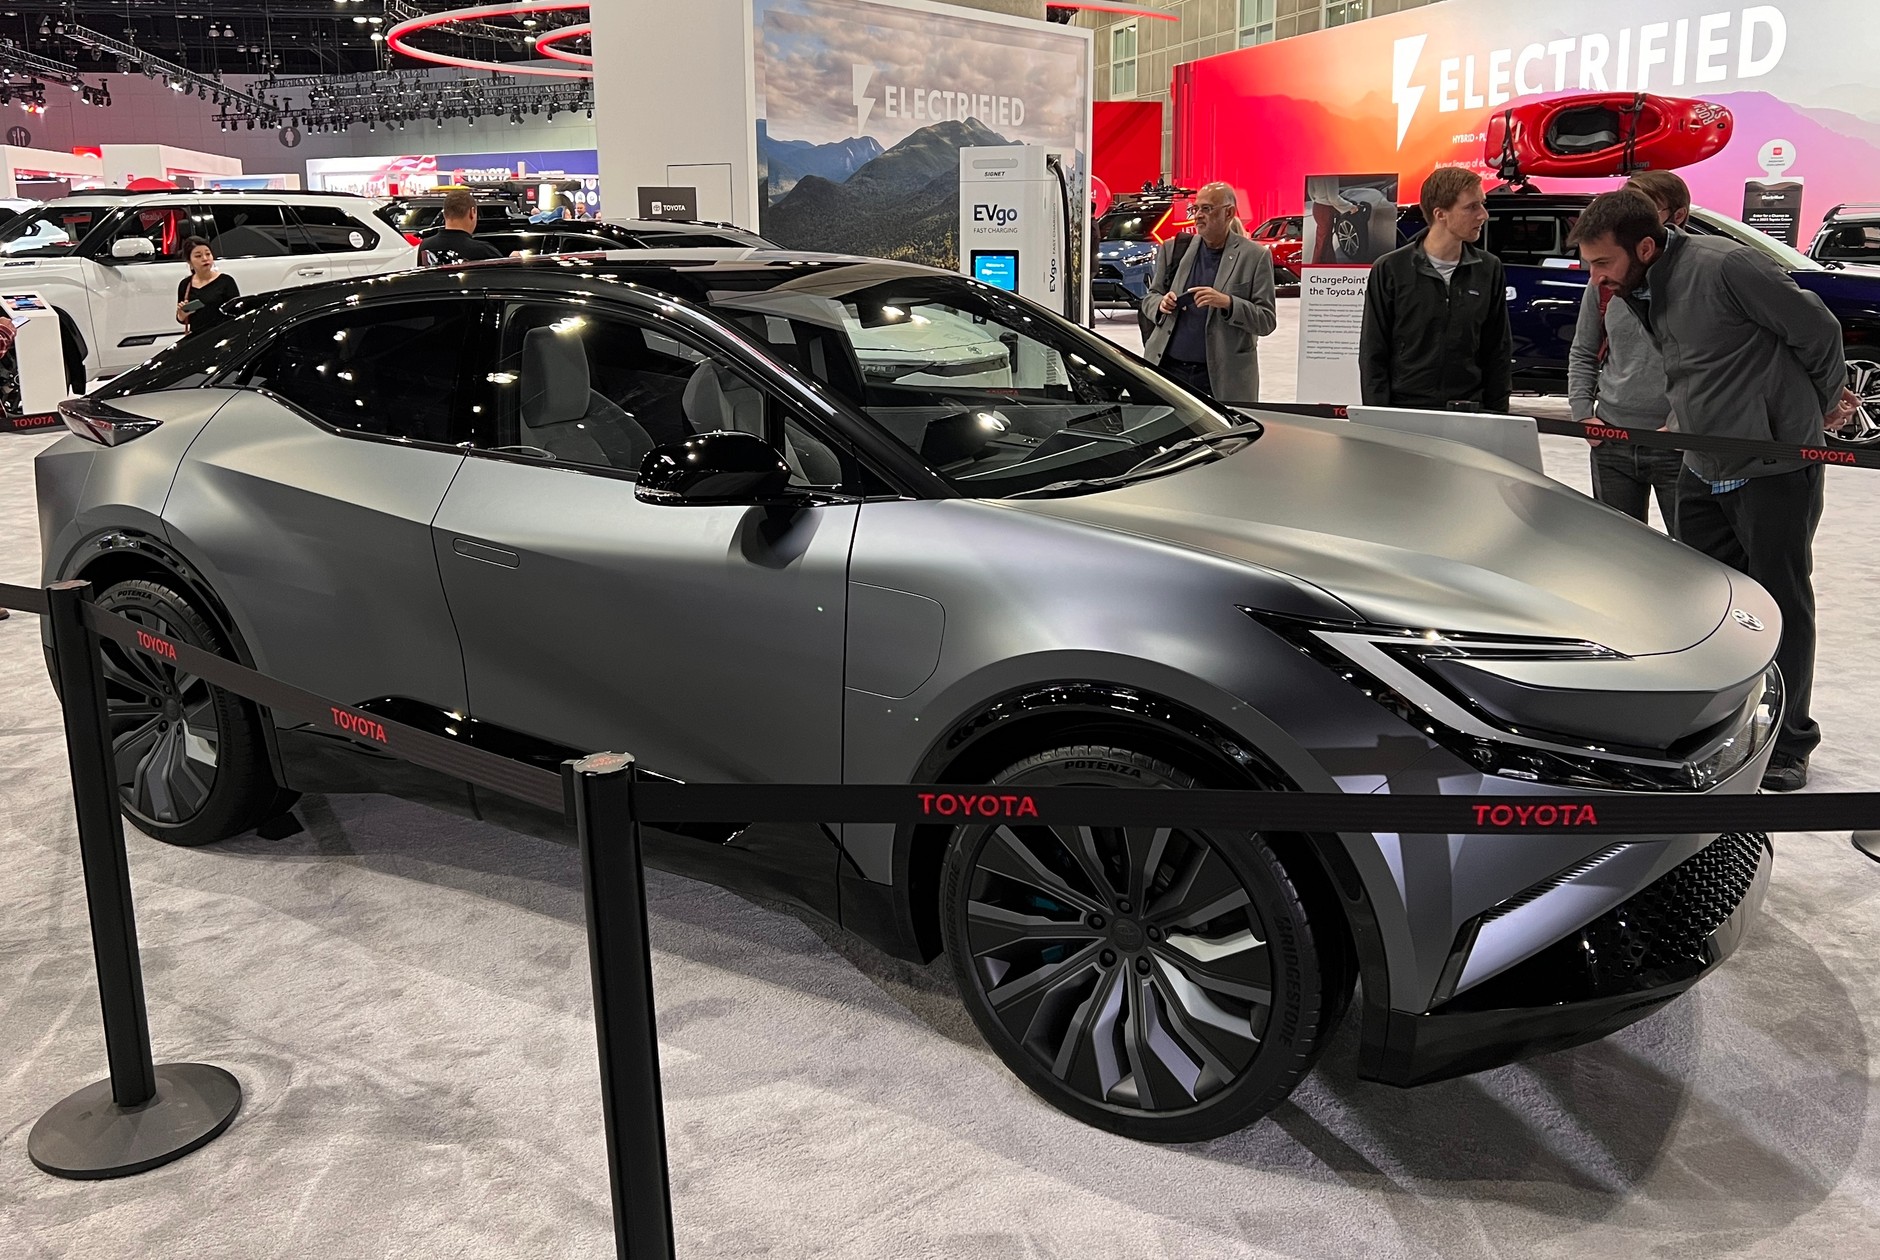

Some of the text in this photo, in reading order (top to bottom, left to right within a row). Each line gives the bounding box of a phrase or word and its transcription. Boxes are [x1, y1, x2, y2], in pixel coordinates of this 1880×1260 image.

[1438, 5, 1787, 113] ELECTRIFIED
[885, 85, 1025, 126] ELECTRIFIED
[464, 168, 511, 181] TOYOTA
[974, 204, 1018, 226] EVgo
[1049, 258, 1057, 292] EVgo
[1310, 287, 1324, 295] the
[1326, 287, 1355, 297] Toyota
[13, 415, 55, 427] TOYOTA
[1585, 426, 1629, 440] TOYOTA
[1800, 448, 1856, 463] TOYOTA
[117, 590, 152, 600] POTENZA
[137, 630, 177, 660] TOYOTA
[331, 707, 387, 744] TOYOTA
[1064, 760, 1141, 778] POTENZA
[917, 793, 1039, 817] TOYOTA
[1472, 804, 1598, 827] TOYOTA
[1274, 916, 1301, 1048] BRIDGESTONE
